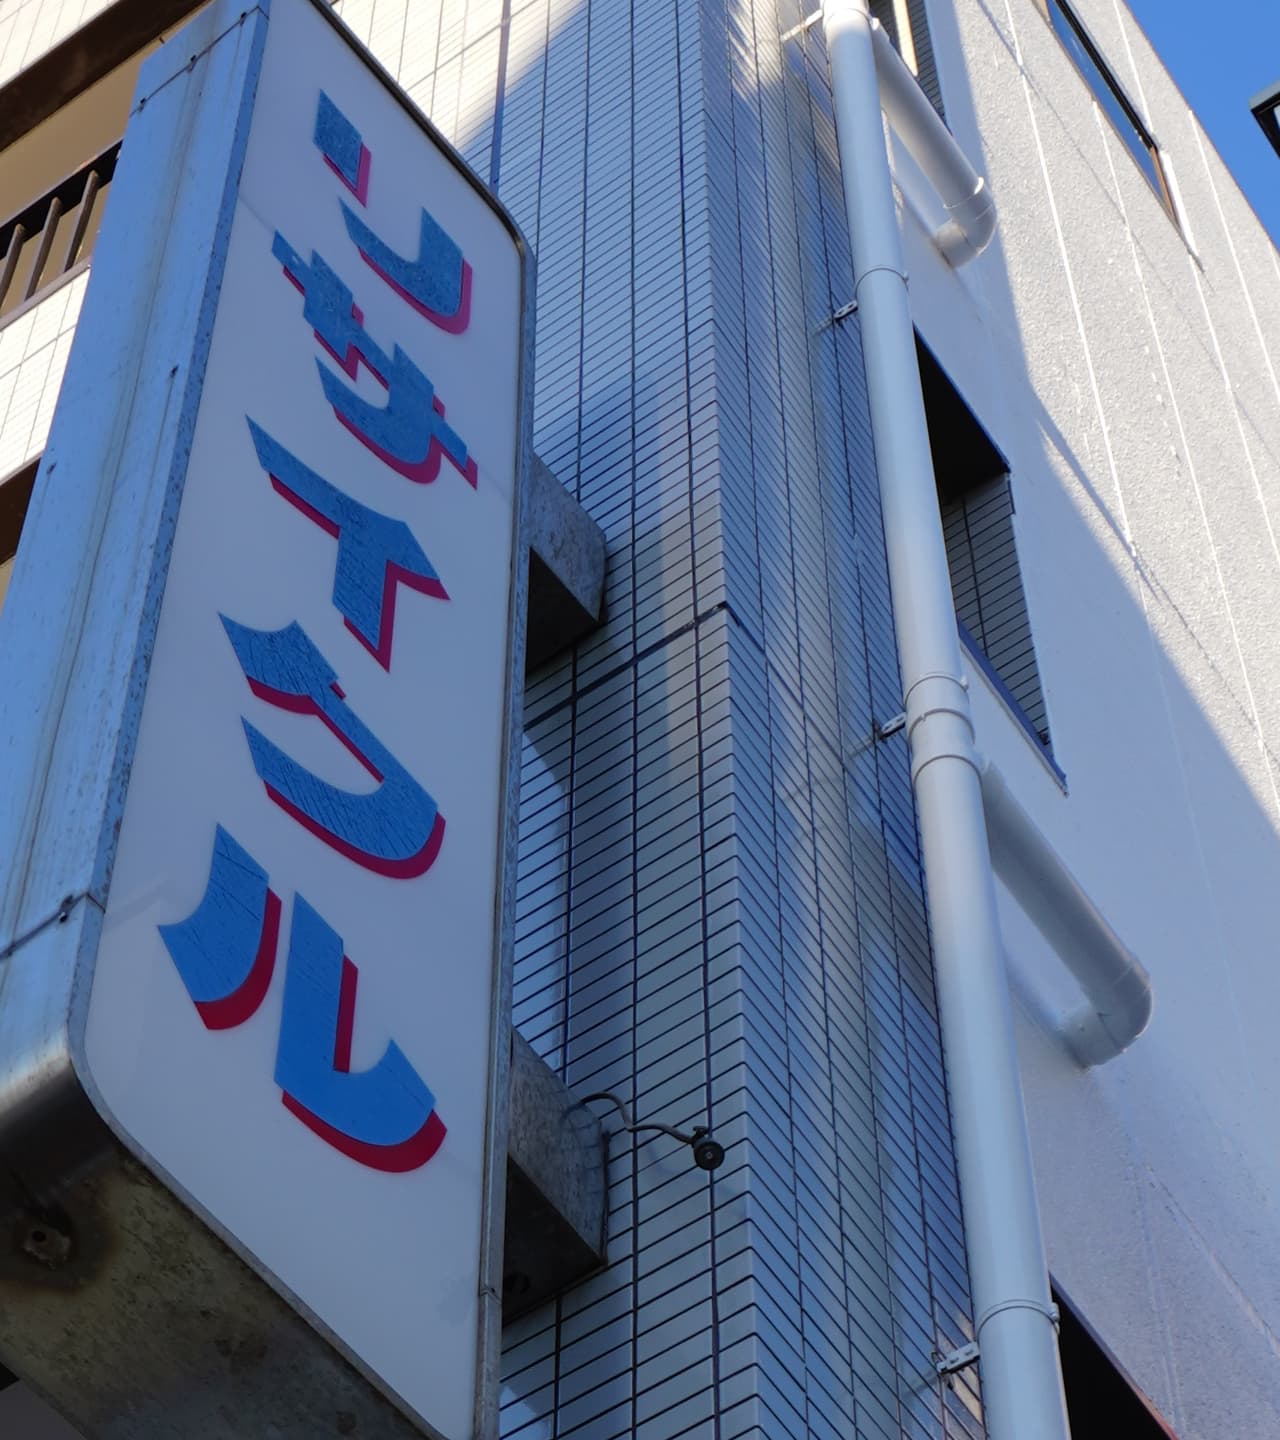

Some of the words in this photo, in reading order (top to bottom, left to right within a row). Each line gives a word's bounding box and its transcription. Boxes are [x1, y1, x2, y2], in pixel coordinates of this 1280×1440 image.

[158, 90, 478, 1174] リサイクル
